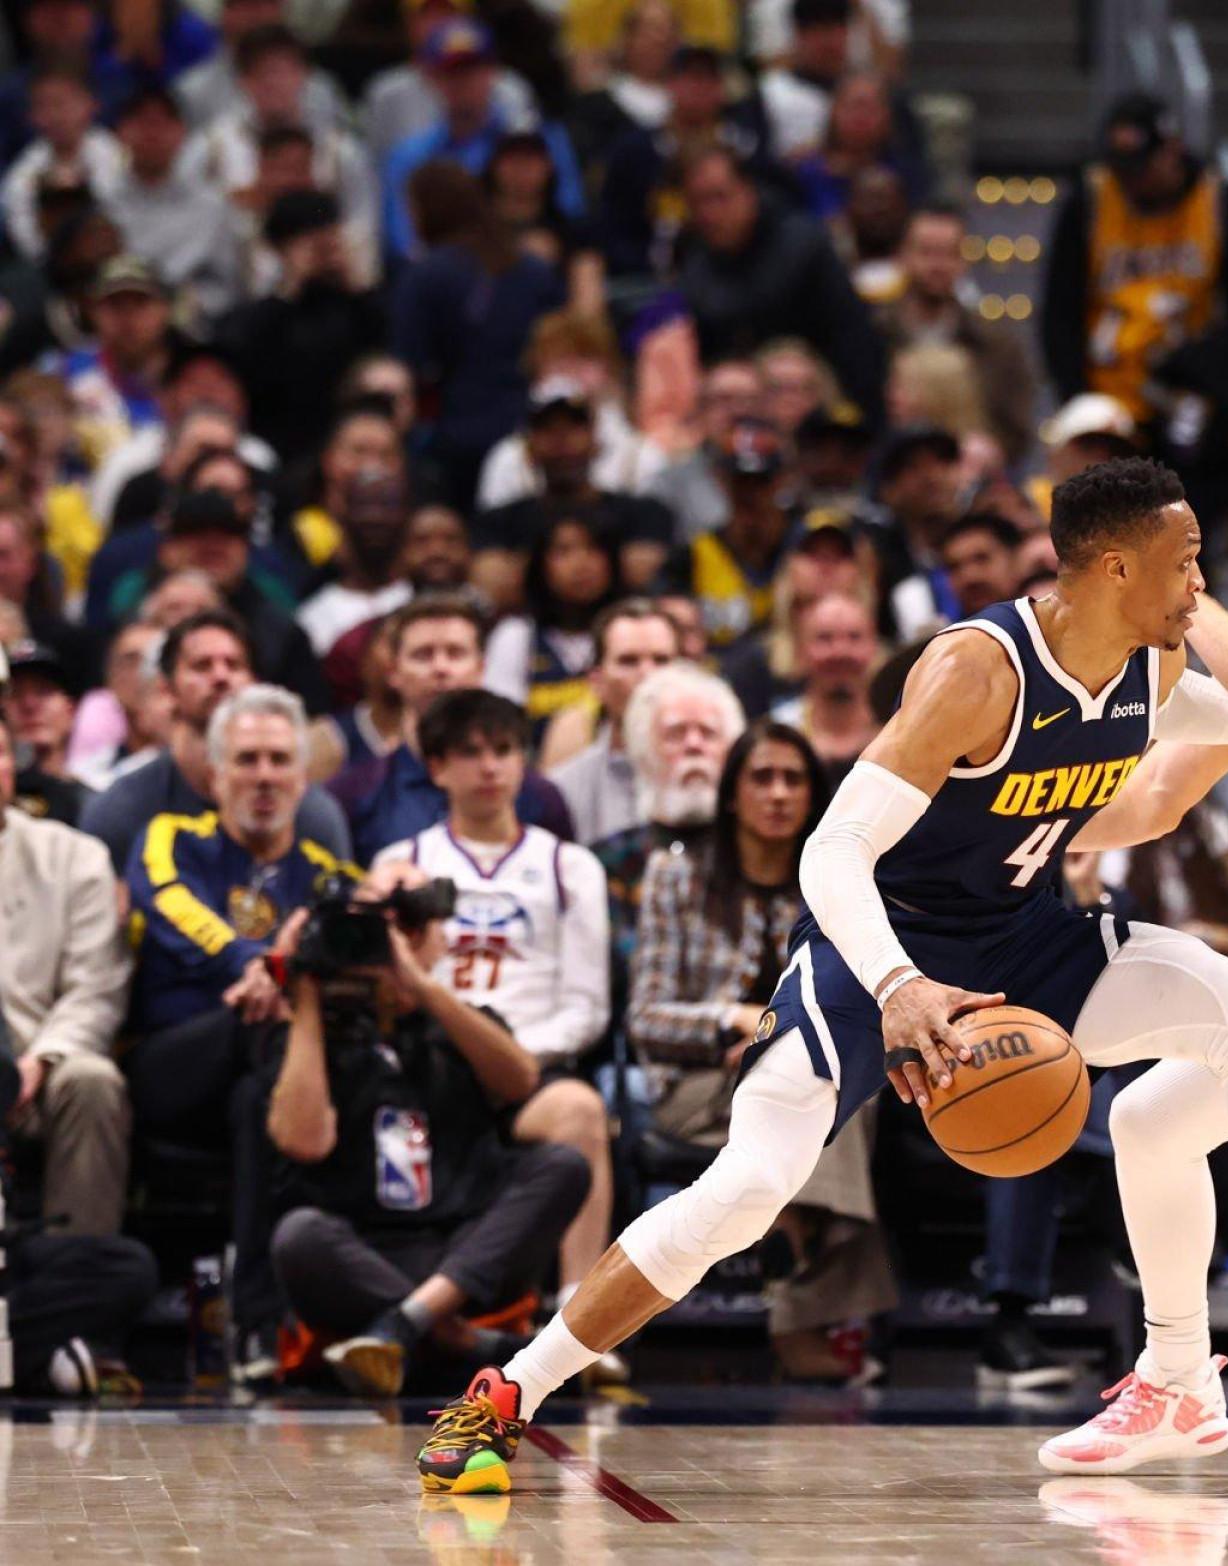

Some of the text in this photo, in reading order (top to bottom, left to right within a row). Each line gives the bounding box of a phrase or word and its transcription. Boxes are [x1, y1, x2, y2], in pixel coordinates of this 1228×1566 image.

[1111, 702, 1146, 719] ibotta
[1003, 818, 1070, 888] 4
[453, 947, 502, 990] 27
